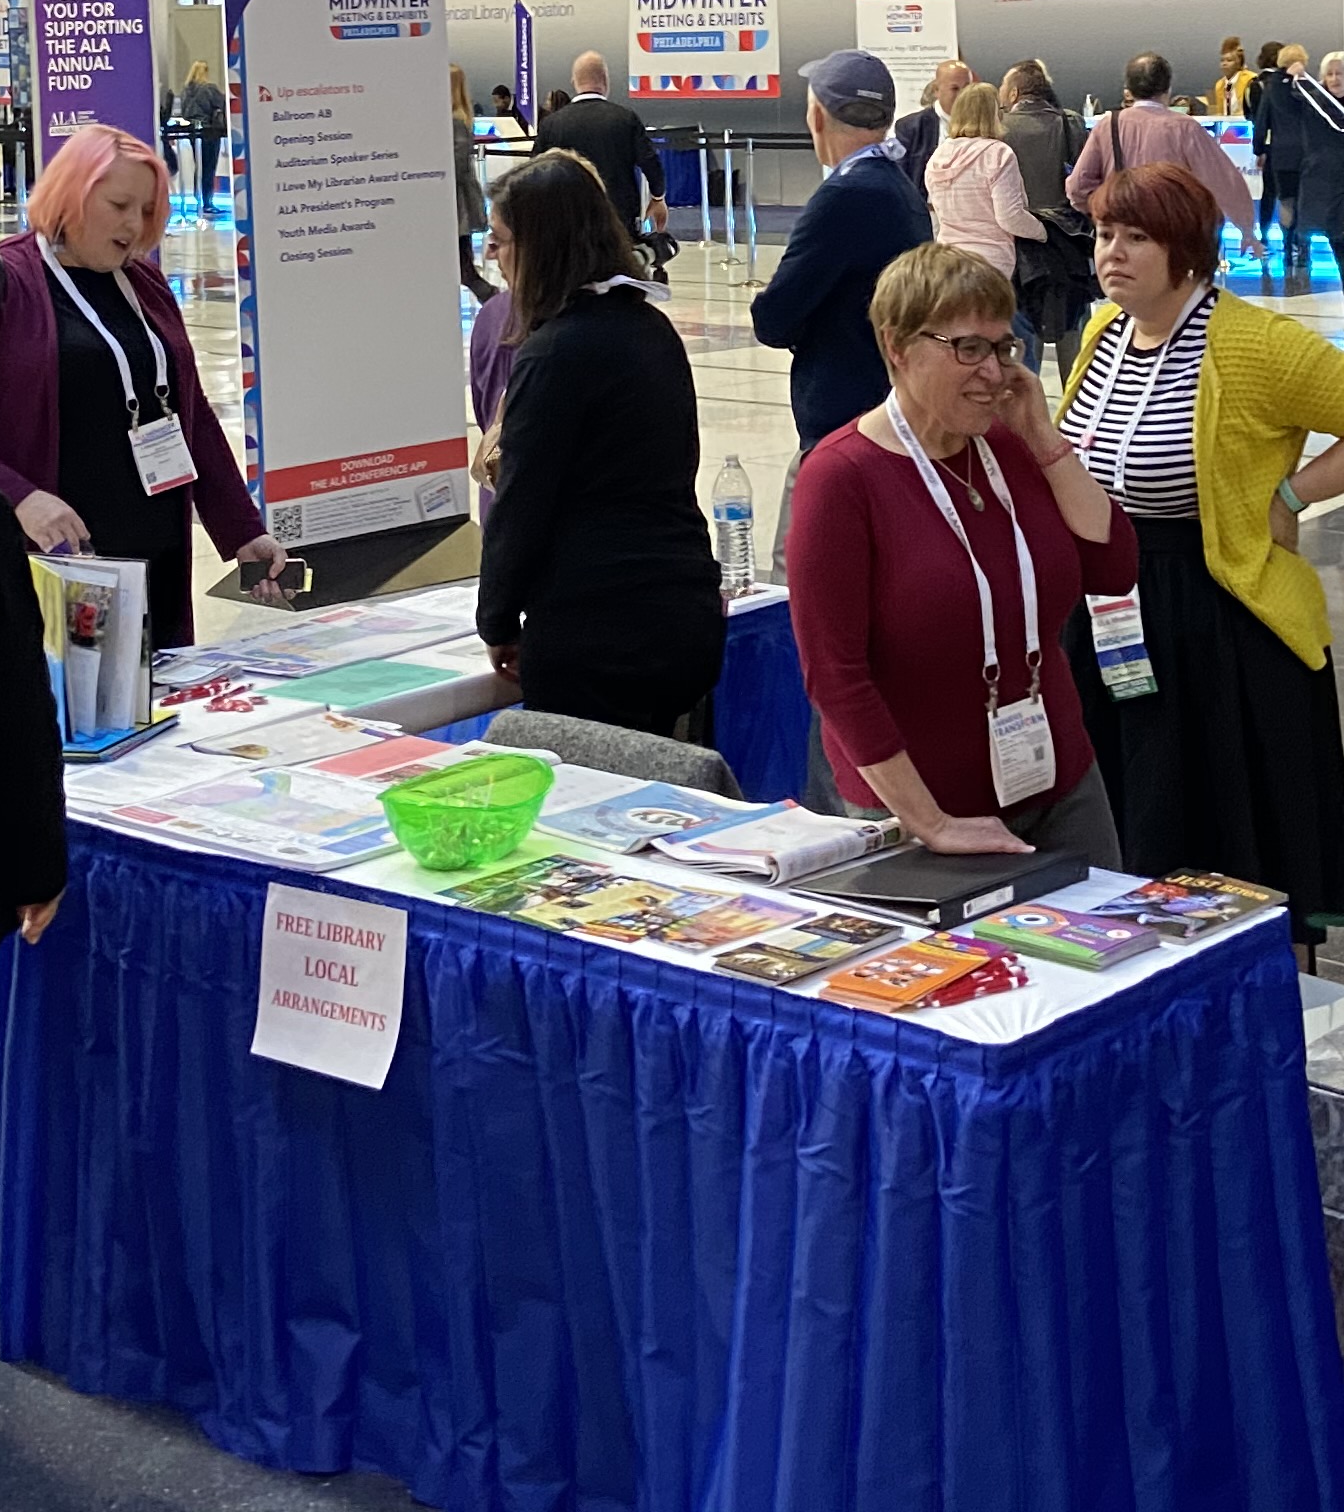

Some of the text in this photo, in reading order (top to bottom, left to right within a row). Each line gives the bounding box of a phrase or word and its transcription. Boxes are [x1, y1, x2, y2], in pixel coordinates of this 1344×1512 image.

[42, 2, 115, 19] YOU FOR
[332, 12, 376, 23] MEETING
[386, 10, 429, 21] EXHIBITS
[44, 19, 144, 37] SUPPORTING
[640, 12, 765, 28] MEETING & EXHIBITS
[45, 38, 112, 55] THE ALA
[653, 36, 721, 49] PHILADELPHIA
[47, 56, 114, 74] ANNUAL
[520, 17, 530, 106] Special Assistance
[47, 74, 93, 91] FUND
[276, 83, 365, 100] Up escalators to
[49, 111, 78, 126] ALA
[272, 109, 332, 123] Ballroom AB
[274, 130, 353, 146] Opening Session
[275, 150, 399, 169] Auditorium Speaker Series
[282, 180, 306, 192] Love
[307, 180, 323, 192] My
[325, 175, 367, 189] Librarian
[368, 172, 400, 185] Award
[400, 168, 447, 184] Ceremony
[278, 196, 396, 216] ALA President's Program
[278, 220, 377, 239] Youth Media Awards
[279, 246, 354, 264] Closing Session
[341, 453, 395, 472] DOWNLOAD
[309, 460, 428, 491] THE ALA CONFERENCE APP
[276, 911, 386, 952] FREE LIBRARY
[304, 956, 359, 987] LOCAL
[271, 988, 387, 1032] ARRANGEMENTS
